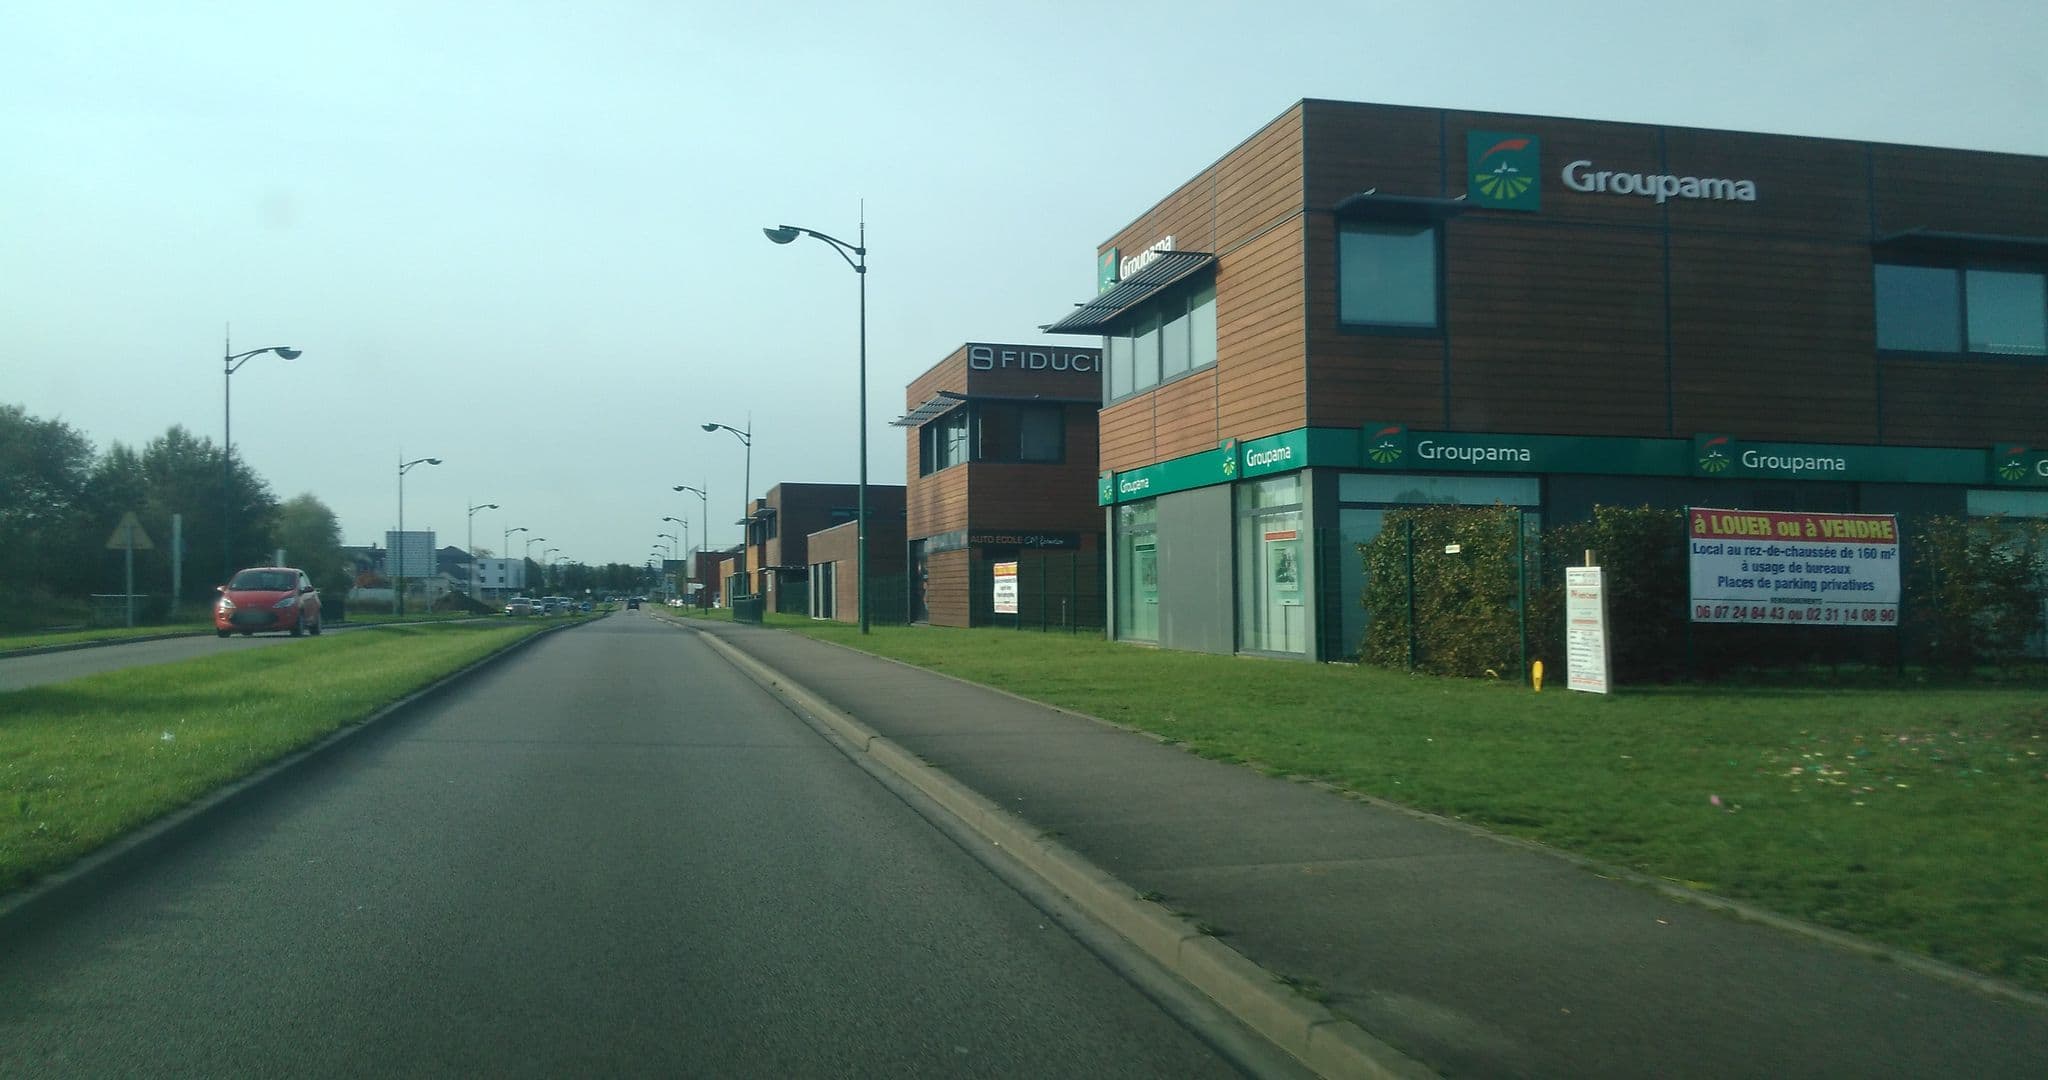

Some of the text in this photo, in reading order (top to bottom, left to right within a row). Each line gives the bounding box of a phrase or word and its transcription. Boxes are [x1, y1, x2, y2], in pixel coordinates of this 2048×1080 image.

[1561, 160, 1756, 204] Groupama
[1001, 351, 1099, 372] FIDUCI
[1246, 446, 1291, 467] Groupama
[1417, 440, 1531, 465] Groupama
[1742, 450, 1846, 474] Groupama
[1120, 478, 1150, 494] Groupama
[1695, 514, 1894, 539] à LOUER ou à VENDRE
[1693, 543, 1723, 555] Local
[1728, 546, 1741, 556] au
[1744, 545, 1837, 558] rez-de-chaussée
[1840, 547, 1853, 559] de
[1742, 560, 1850, 575] à usage de bureaux
[1718, 576, 1874, 592] Places de parking privatives
[1696, 605, 1710, 619] 06
[1715, 606, 1728, 619] 07
[1733, 606, 1747, 619] 24
[1752, 606, 1765, 620] 84
[1770, 607, 1784, 620] 43
[1788, 610, 1803, 620] ou
[1807, 607, 1820, 620] 02
[1825, 608, 1838, 621] 31
[1880, 609, 1895, 622] 90
